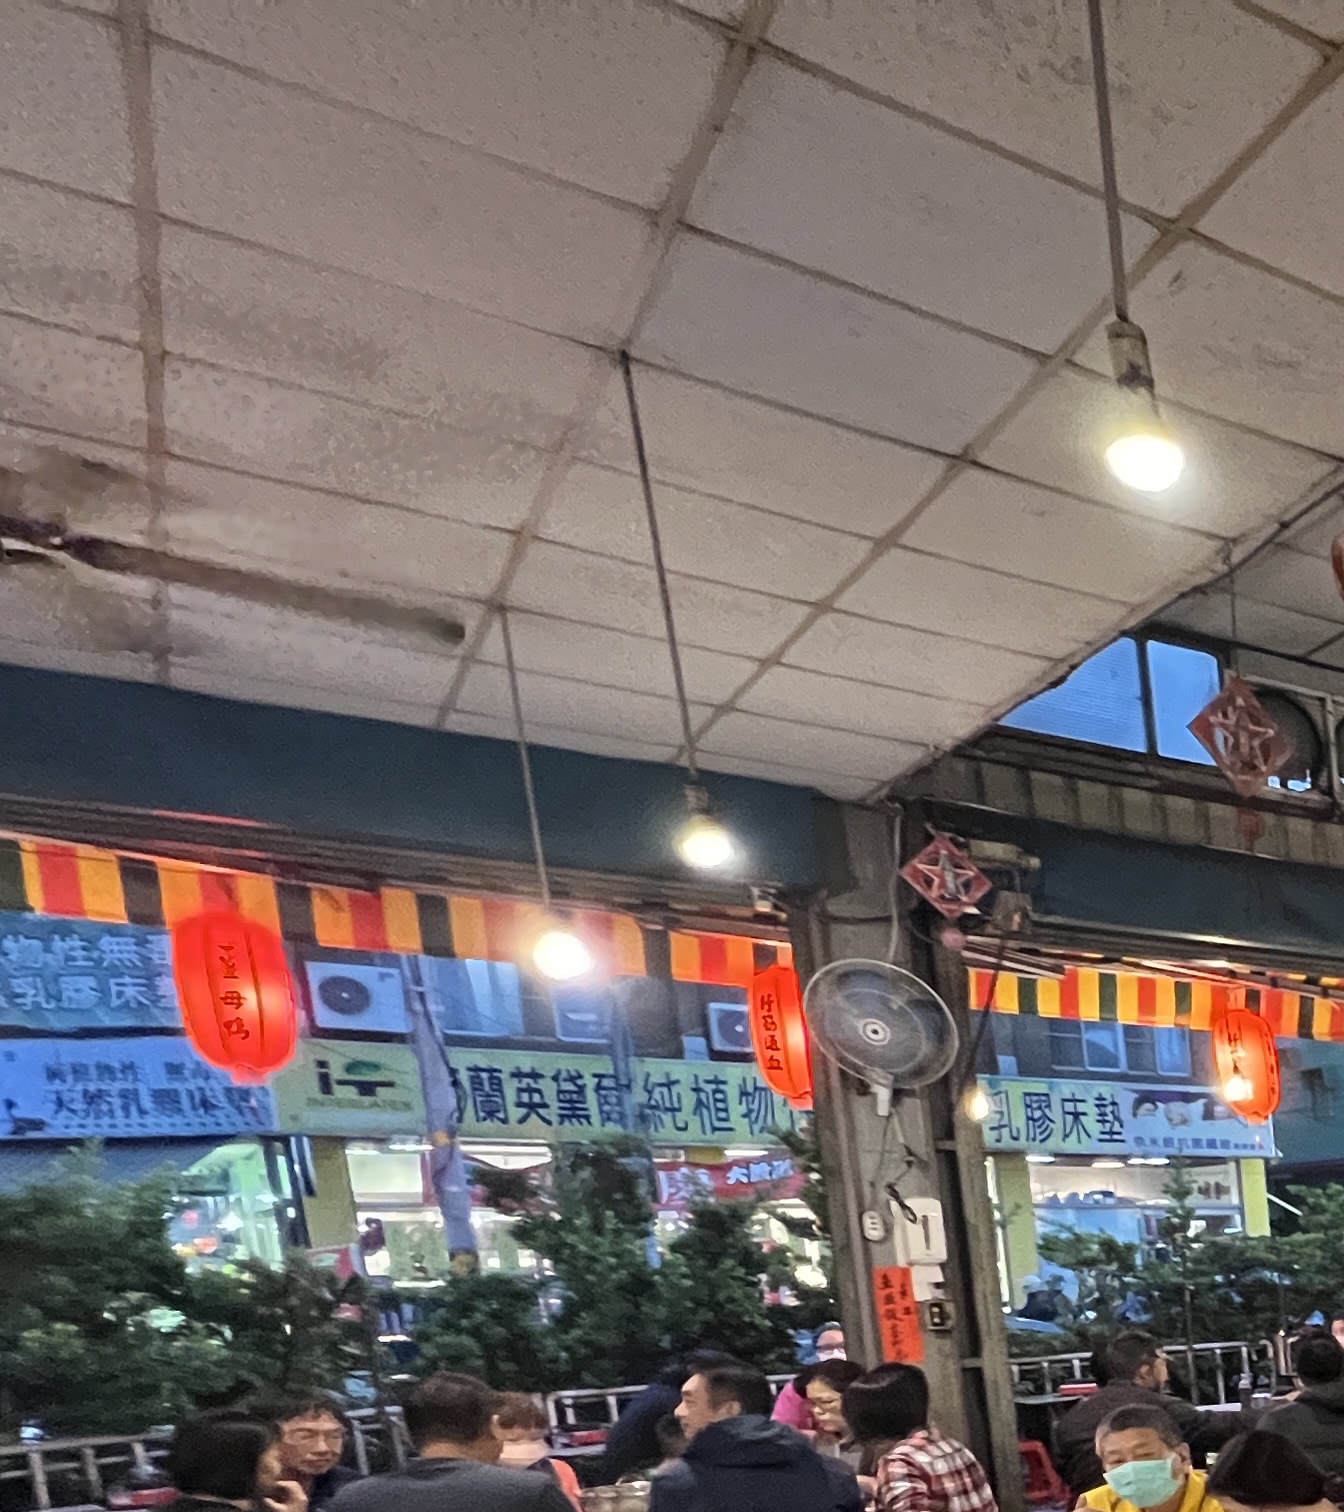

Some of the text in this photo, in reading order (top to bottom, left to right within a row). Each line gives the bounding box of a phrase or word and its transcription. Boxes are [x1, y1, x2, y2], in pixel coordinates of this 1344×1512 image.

[452, 1063, 814, 1137] 蘭英黛爾純植物
[988, 1088, 1126, 1145] 乳膠床墊
